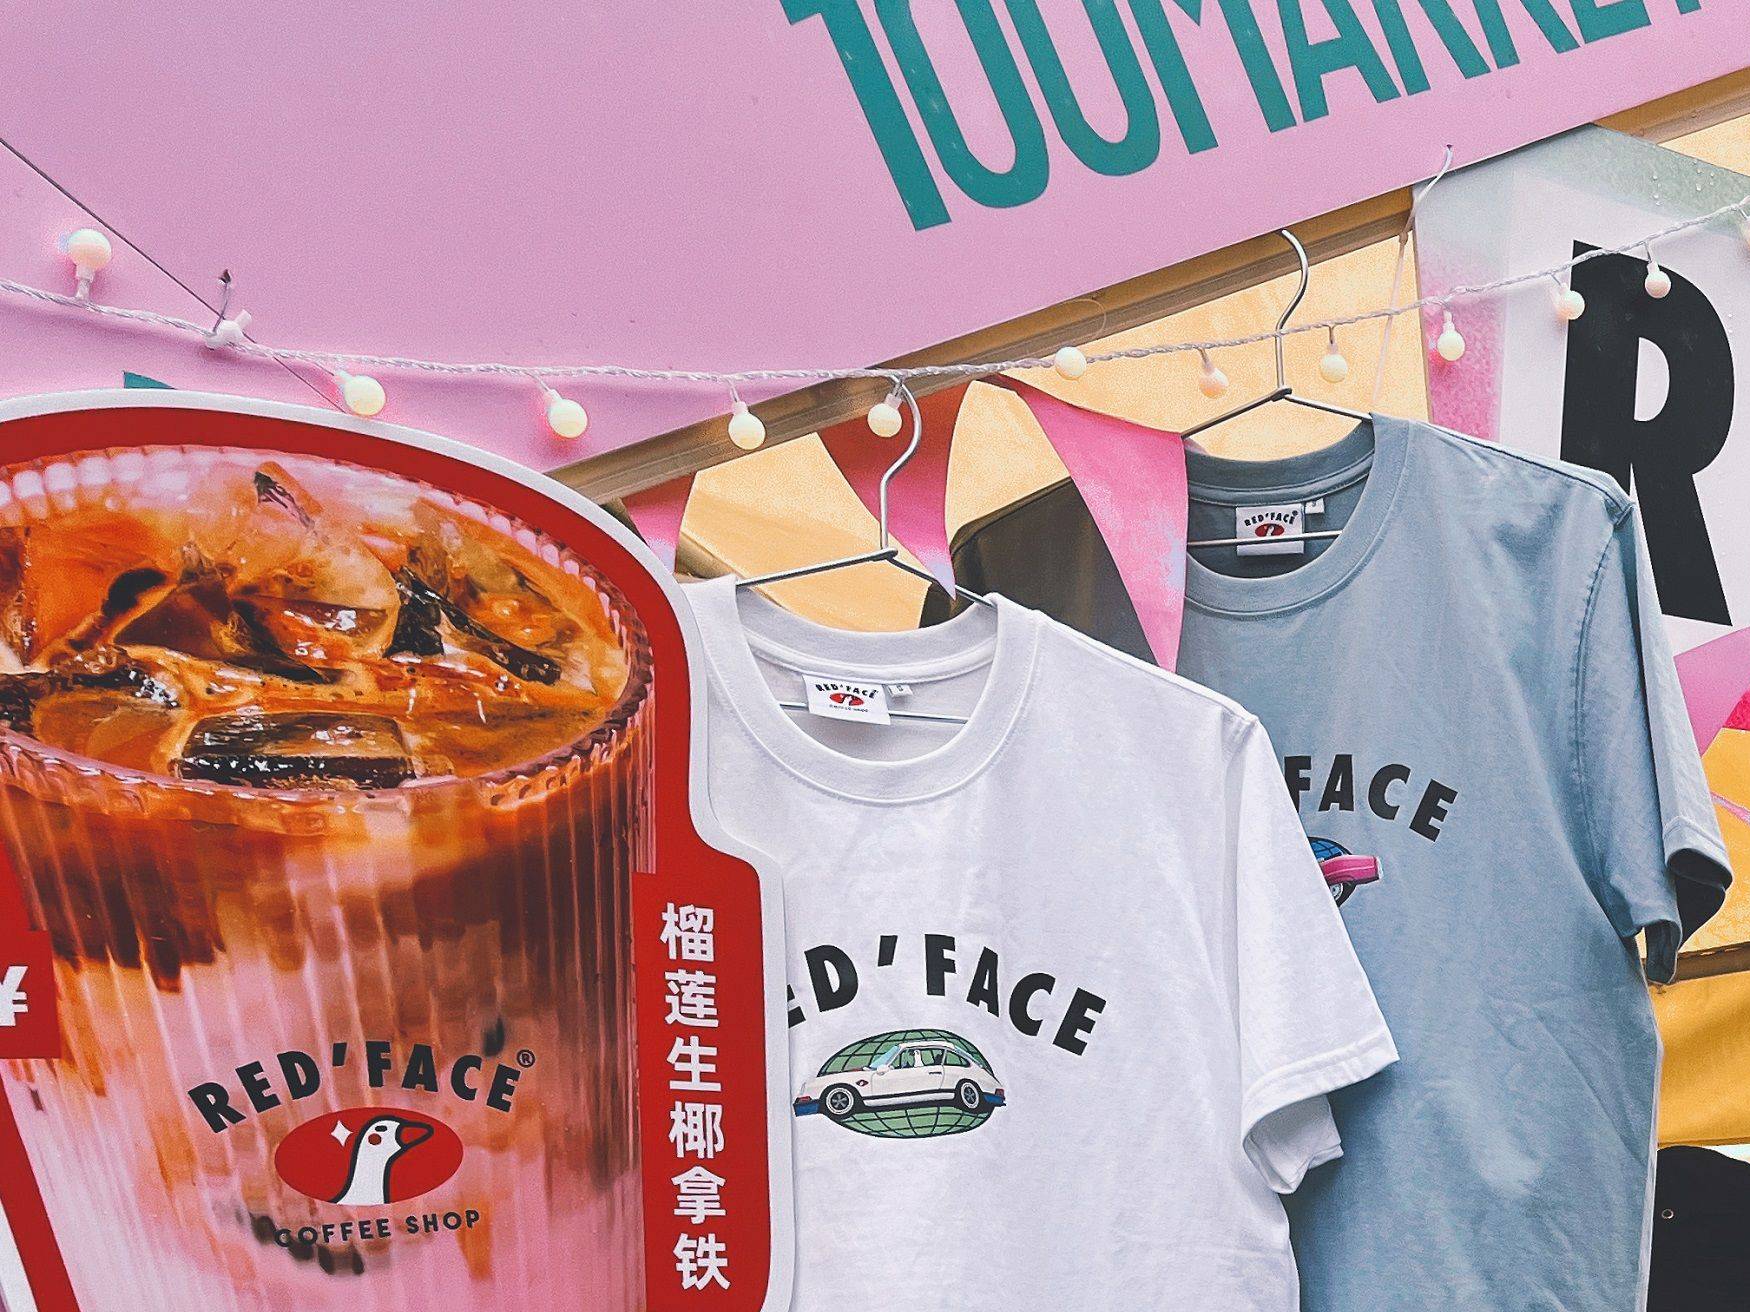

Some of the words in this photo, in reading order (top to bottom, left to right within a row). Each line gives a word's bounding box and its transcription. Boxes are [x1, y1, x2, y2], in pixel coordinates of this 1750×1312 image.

[187, 1041, 521, 1134] RED'FACE
[660, 902, 732, 1292] 榴莲生椰拿铁
[275, 1218, 391, 1247] COFFEE
[405, 1209, 480, 1234] SHOP
